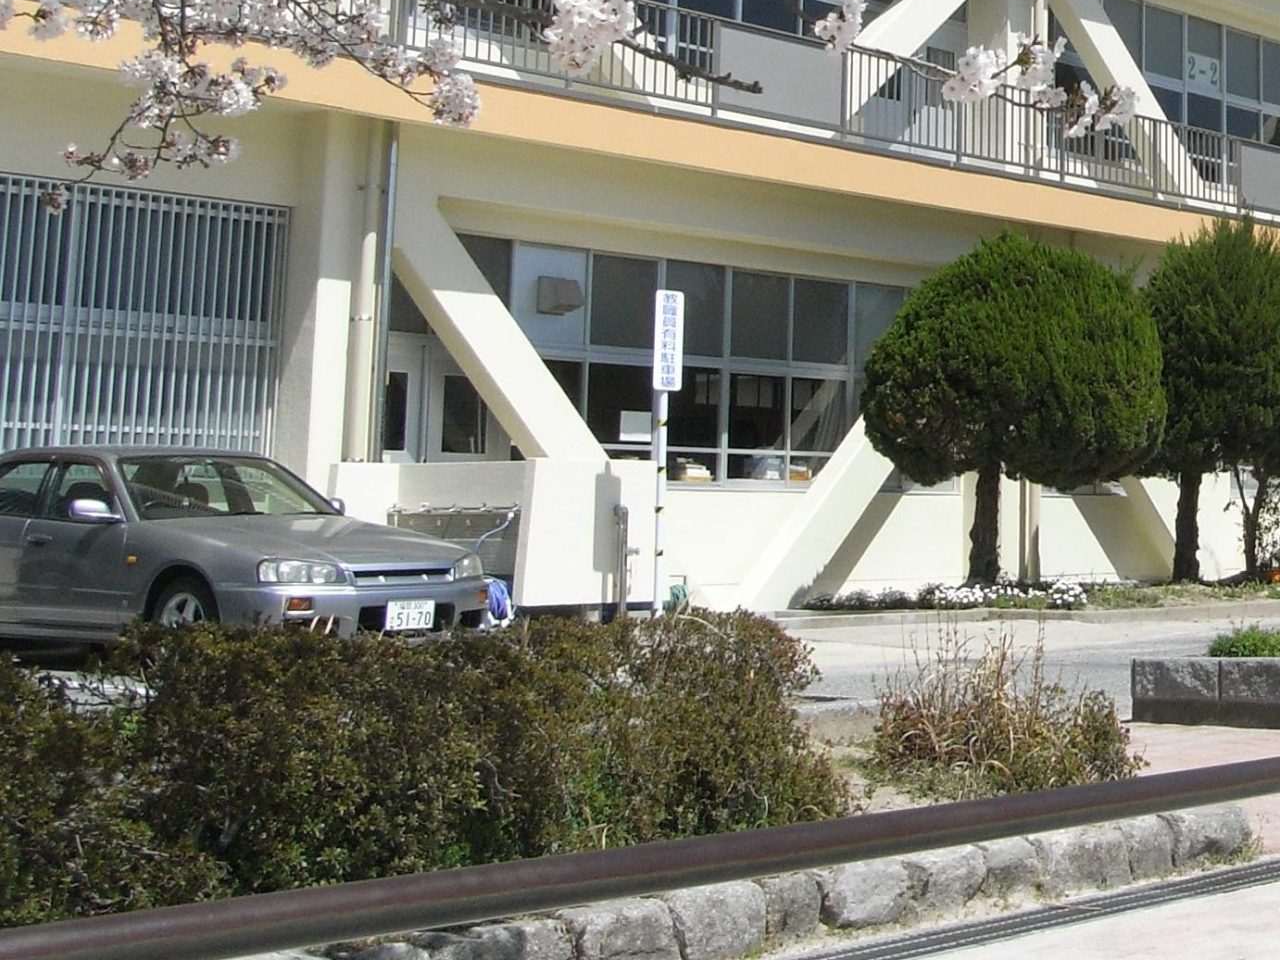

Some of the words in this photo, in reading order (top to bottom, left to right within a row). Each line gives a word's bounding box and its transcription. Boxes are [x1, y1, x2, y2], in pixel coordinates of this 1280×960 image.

[1188, 56, 1218, 86] 2-2
[661, 293, 678, 387] 教職員有料駐車場
[396, 611, 432, 627] 51-70
